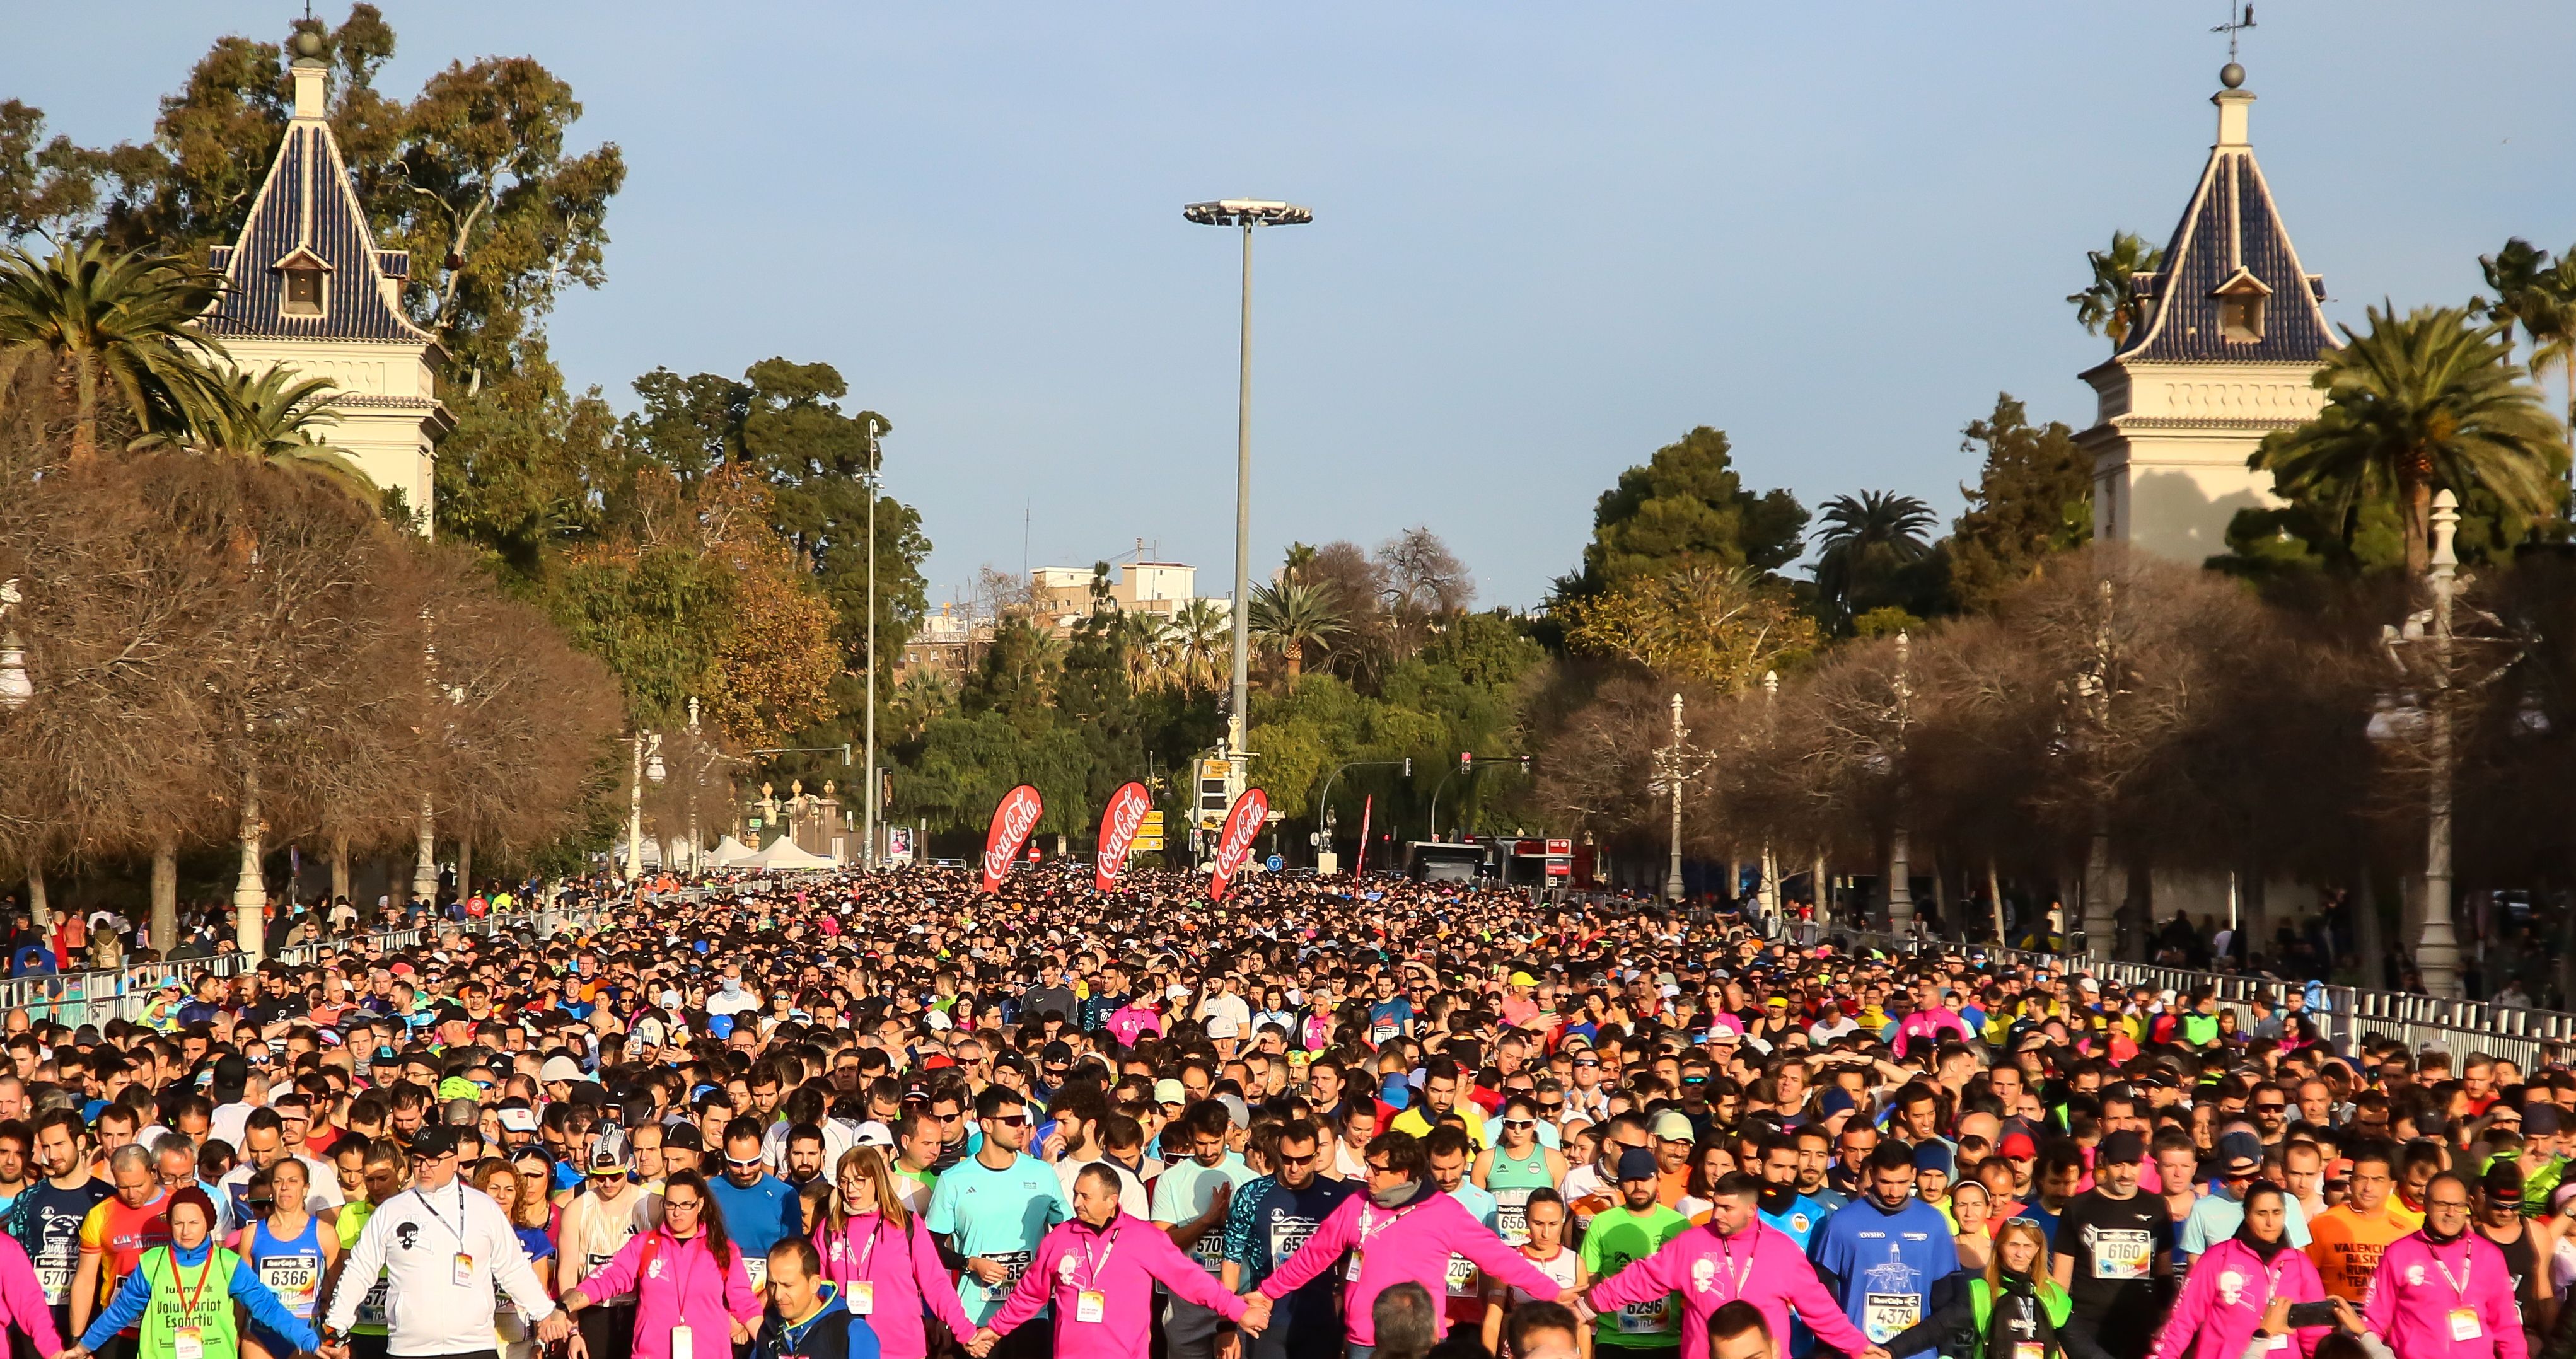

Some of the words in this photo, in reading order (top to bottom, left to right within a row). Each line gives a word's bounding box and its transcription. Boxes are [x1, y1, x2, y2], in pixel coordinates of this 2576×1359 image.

[1197, 1237, 1223, 1253] 570
[2108, 1244, 2140, 1259] 6160
[2334, 1243, 2384, 1252] VALENCI
[2346, 1254, 2377, 1264] BASK
[2347, 1265, 2375, 1275] RUNN
[271, 1270, 308, 1286] 6366
[2347, 1276, 2369, 1287] TEA
[1877, 1308, 1913, 1324] 4379
